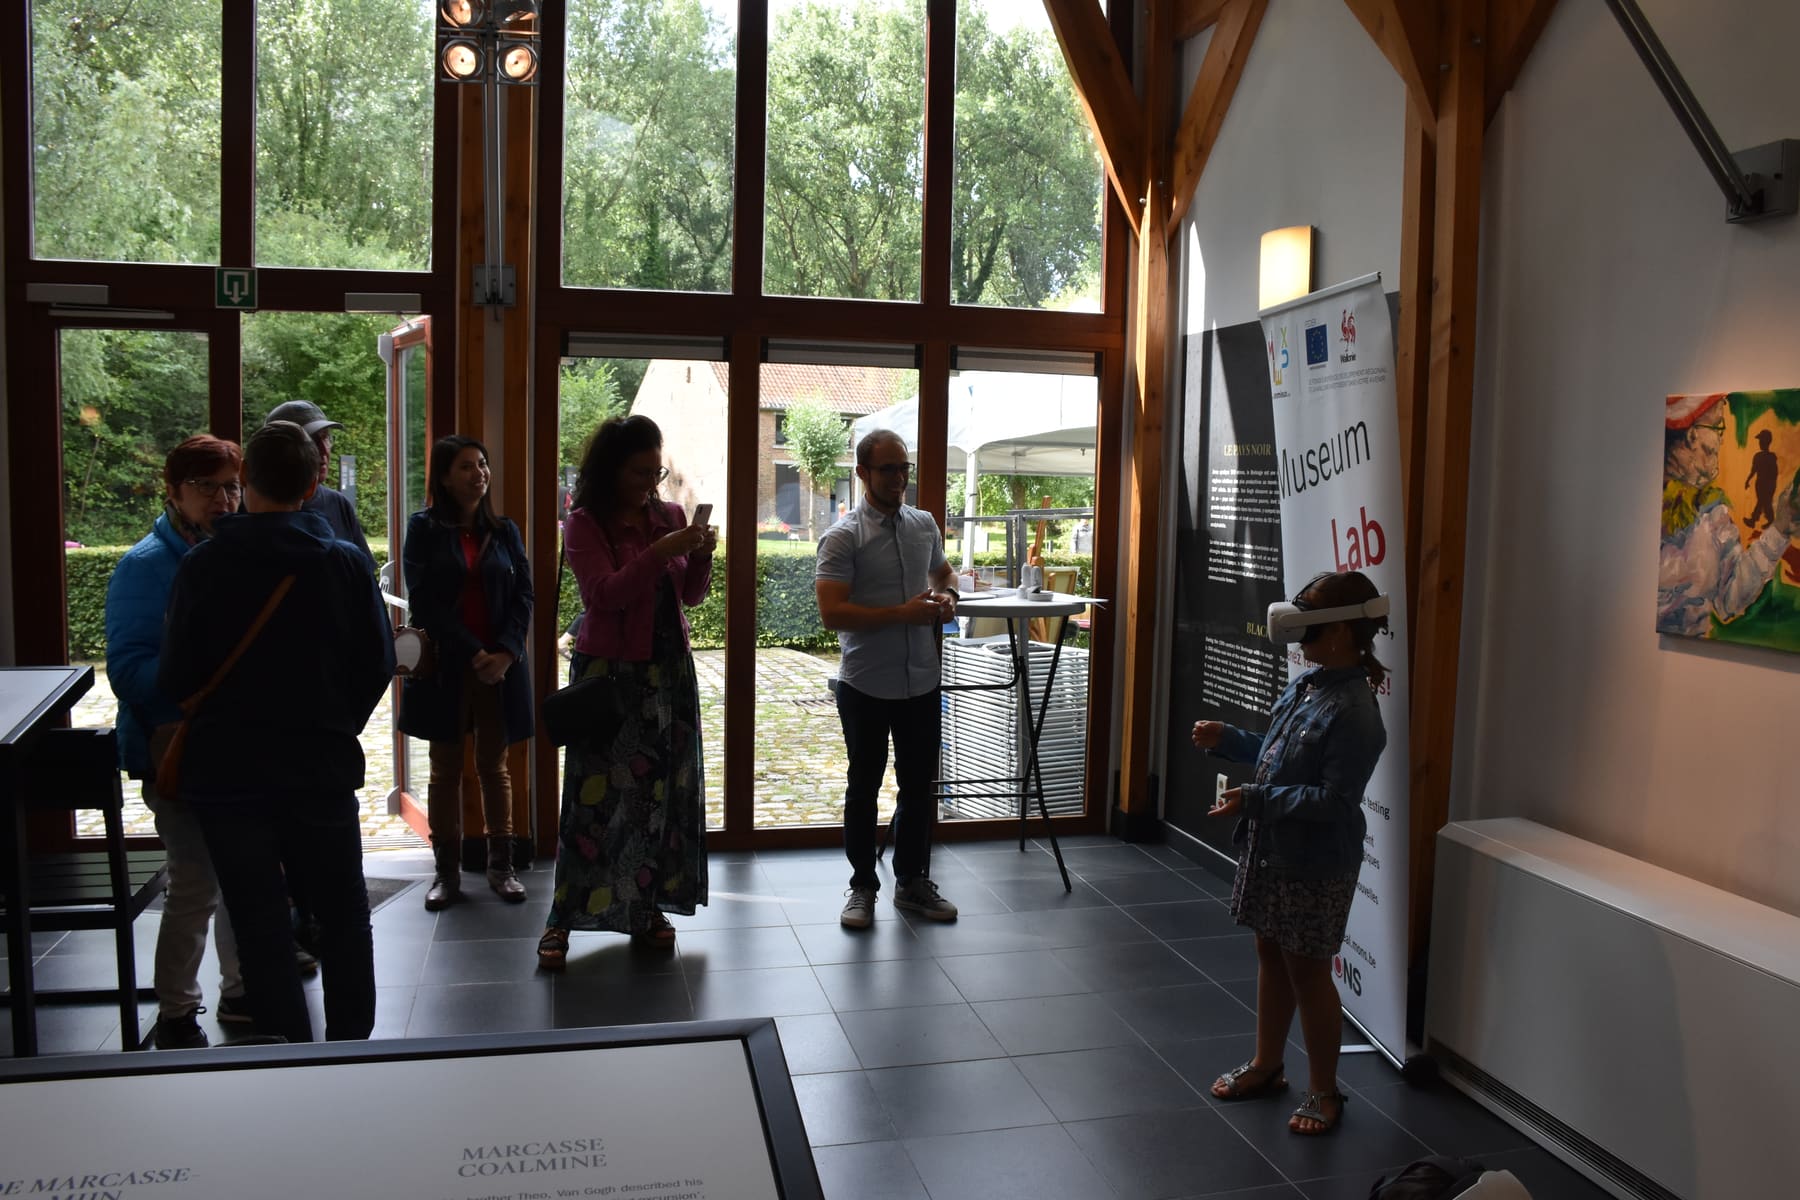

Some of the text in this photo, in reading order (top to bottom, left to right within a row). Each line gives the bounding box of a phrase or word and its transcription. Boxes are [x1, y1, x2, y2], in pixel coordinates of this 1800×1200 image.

[1223, 443, 1272, 456] LE PAYS NOIR
[1279, 421, 1370, 499] Museum
[1331, 506, 1386, 573] Lab
[1246, 622, 1268, 638] BLAC
[1367, 796, 1390, 820] testing
[1357, 882, 1379, 904] ouvelles
[462, 1138, 605, 1161] MARCASSE
[457, 1154, 608, 1178] COALMINE
[0, 1180, 25, 1195] E
[557, 1188, 580, 1197] Van
[584, 1186, 616, 1196] Gogh
[621, 1179, 681, 1192] described
[684, 1177, 704, 1187] his
